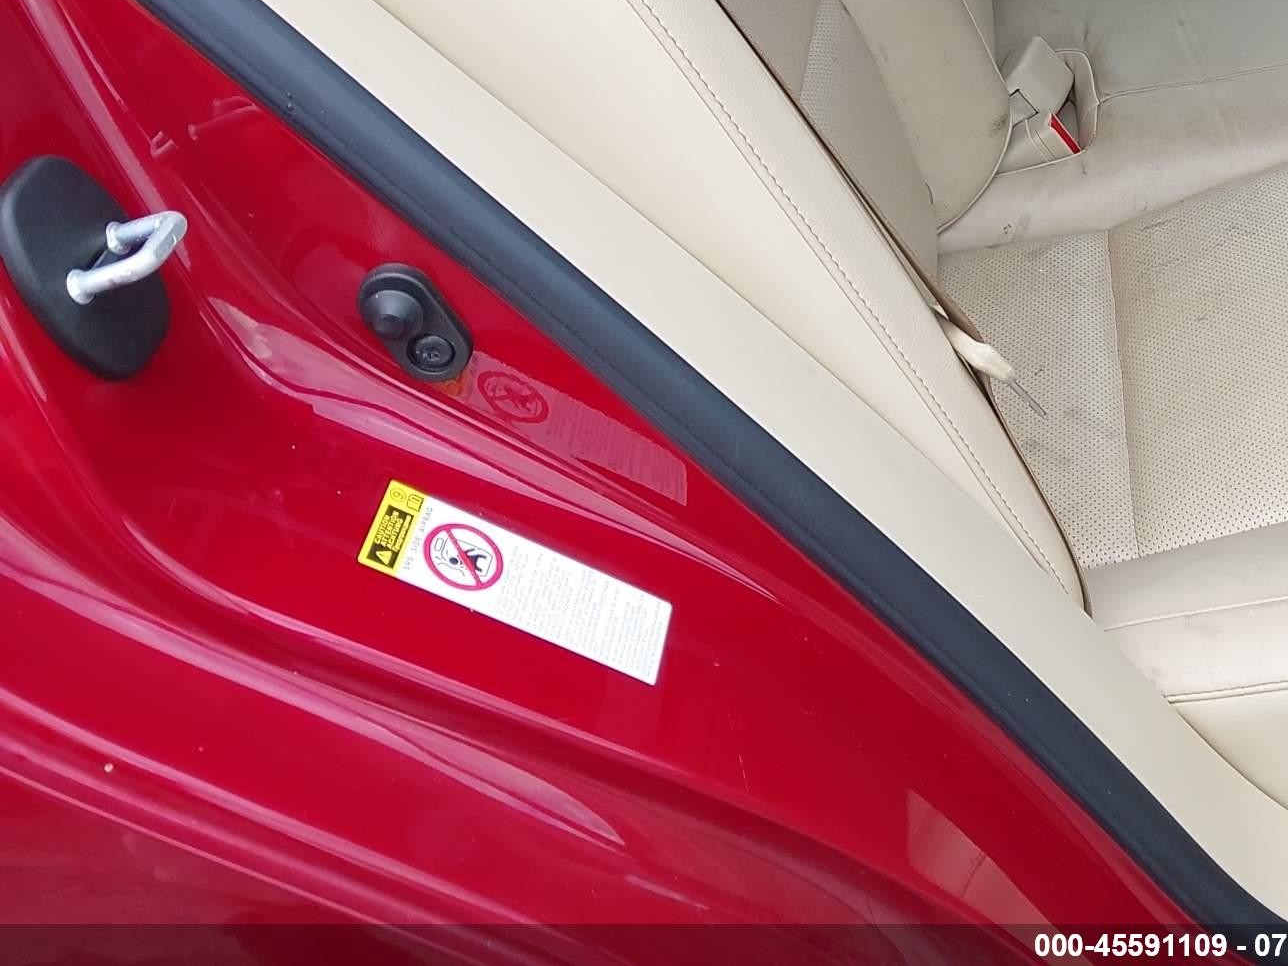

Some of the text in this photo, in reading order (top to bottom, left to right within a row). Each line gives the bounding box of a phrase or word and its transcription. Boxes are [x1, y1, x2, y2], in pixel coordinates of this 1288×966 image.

[374, 514, 390, 544] CAUTION
[380, 510, 400, 547] ATTENTION
[386, 518, 404, 549] ACHTUNG
[419, 507, 433, 532] AIRBAG
